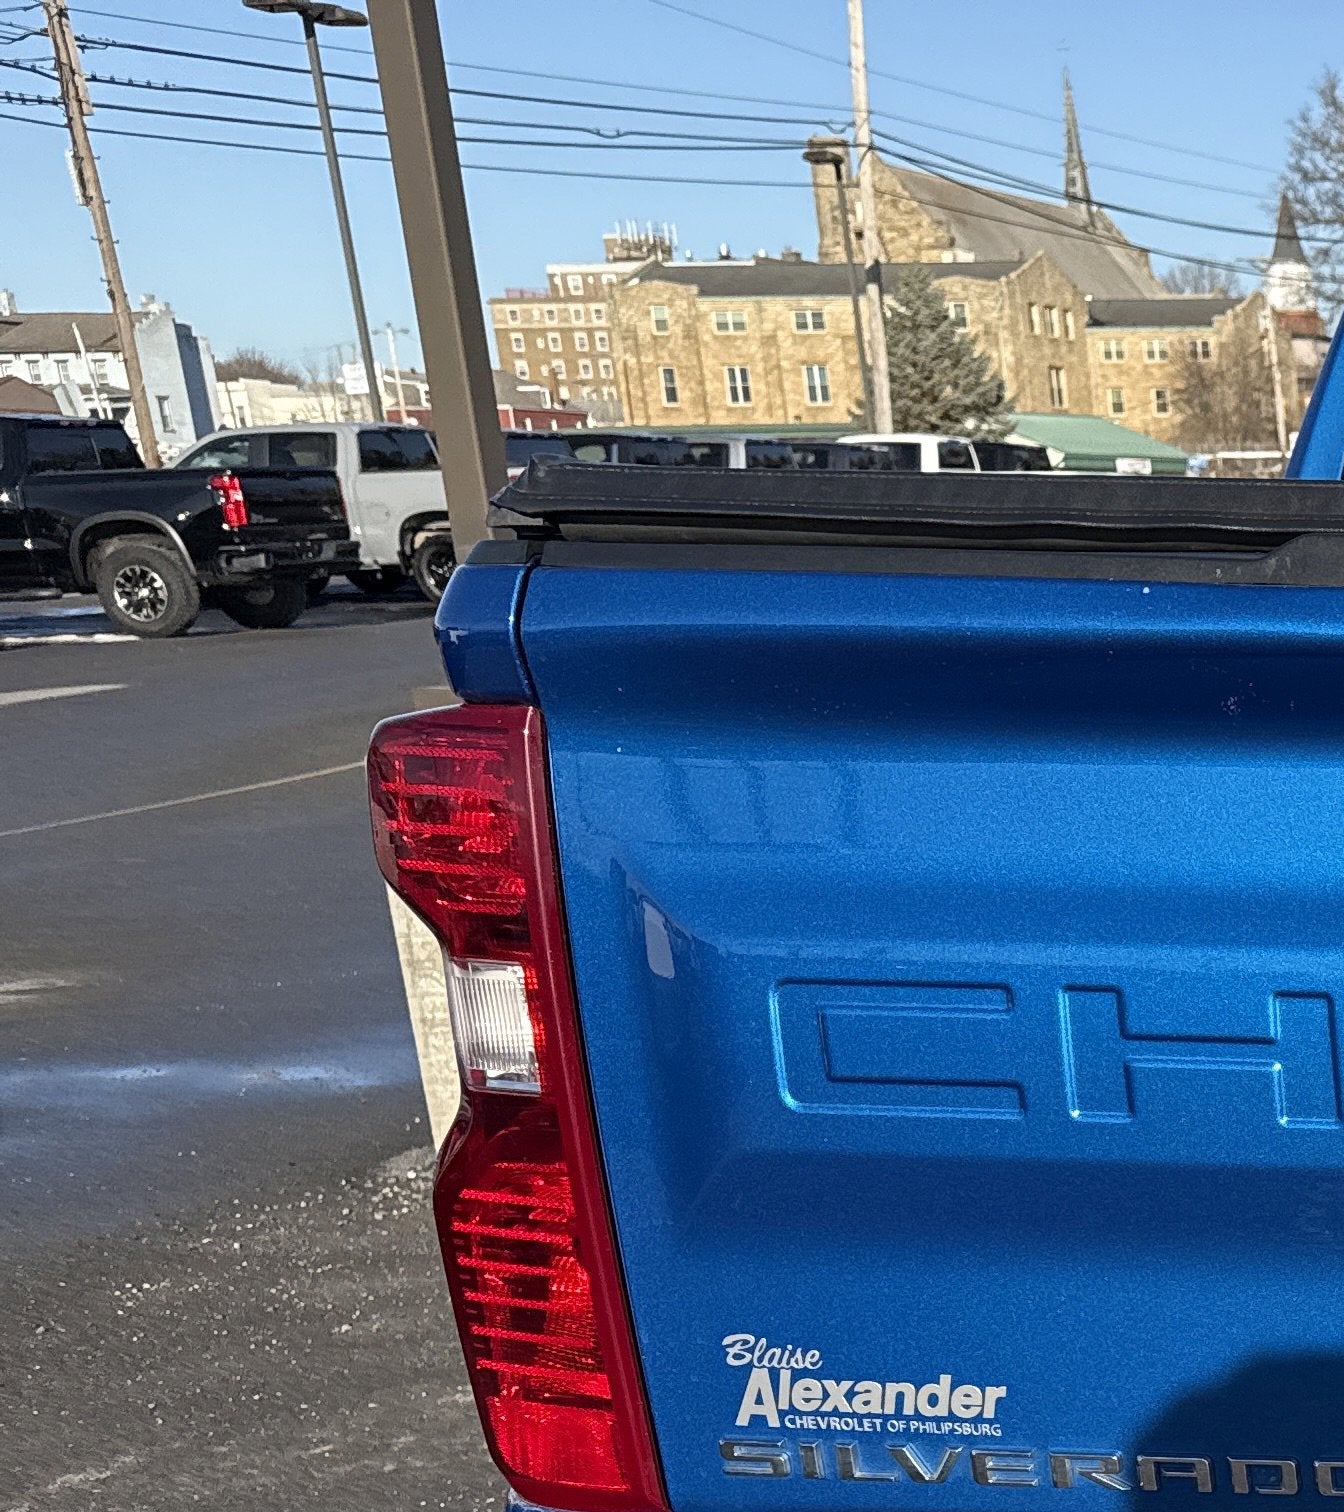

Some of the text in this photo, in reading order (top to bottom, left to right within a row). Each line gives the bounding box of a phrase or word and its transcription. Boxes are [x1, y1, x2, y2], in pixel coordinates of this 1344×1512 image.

[721, 1333, 823, 1370] Blaise
[735, 1366, 1007, 1428] Alexander
[784, 1414, 1003, 1437] CHEVROLET OF PHILIPSBURG
